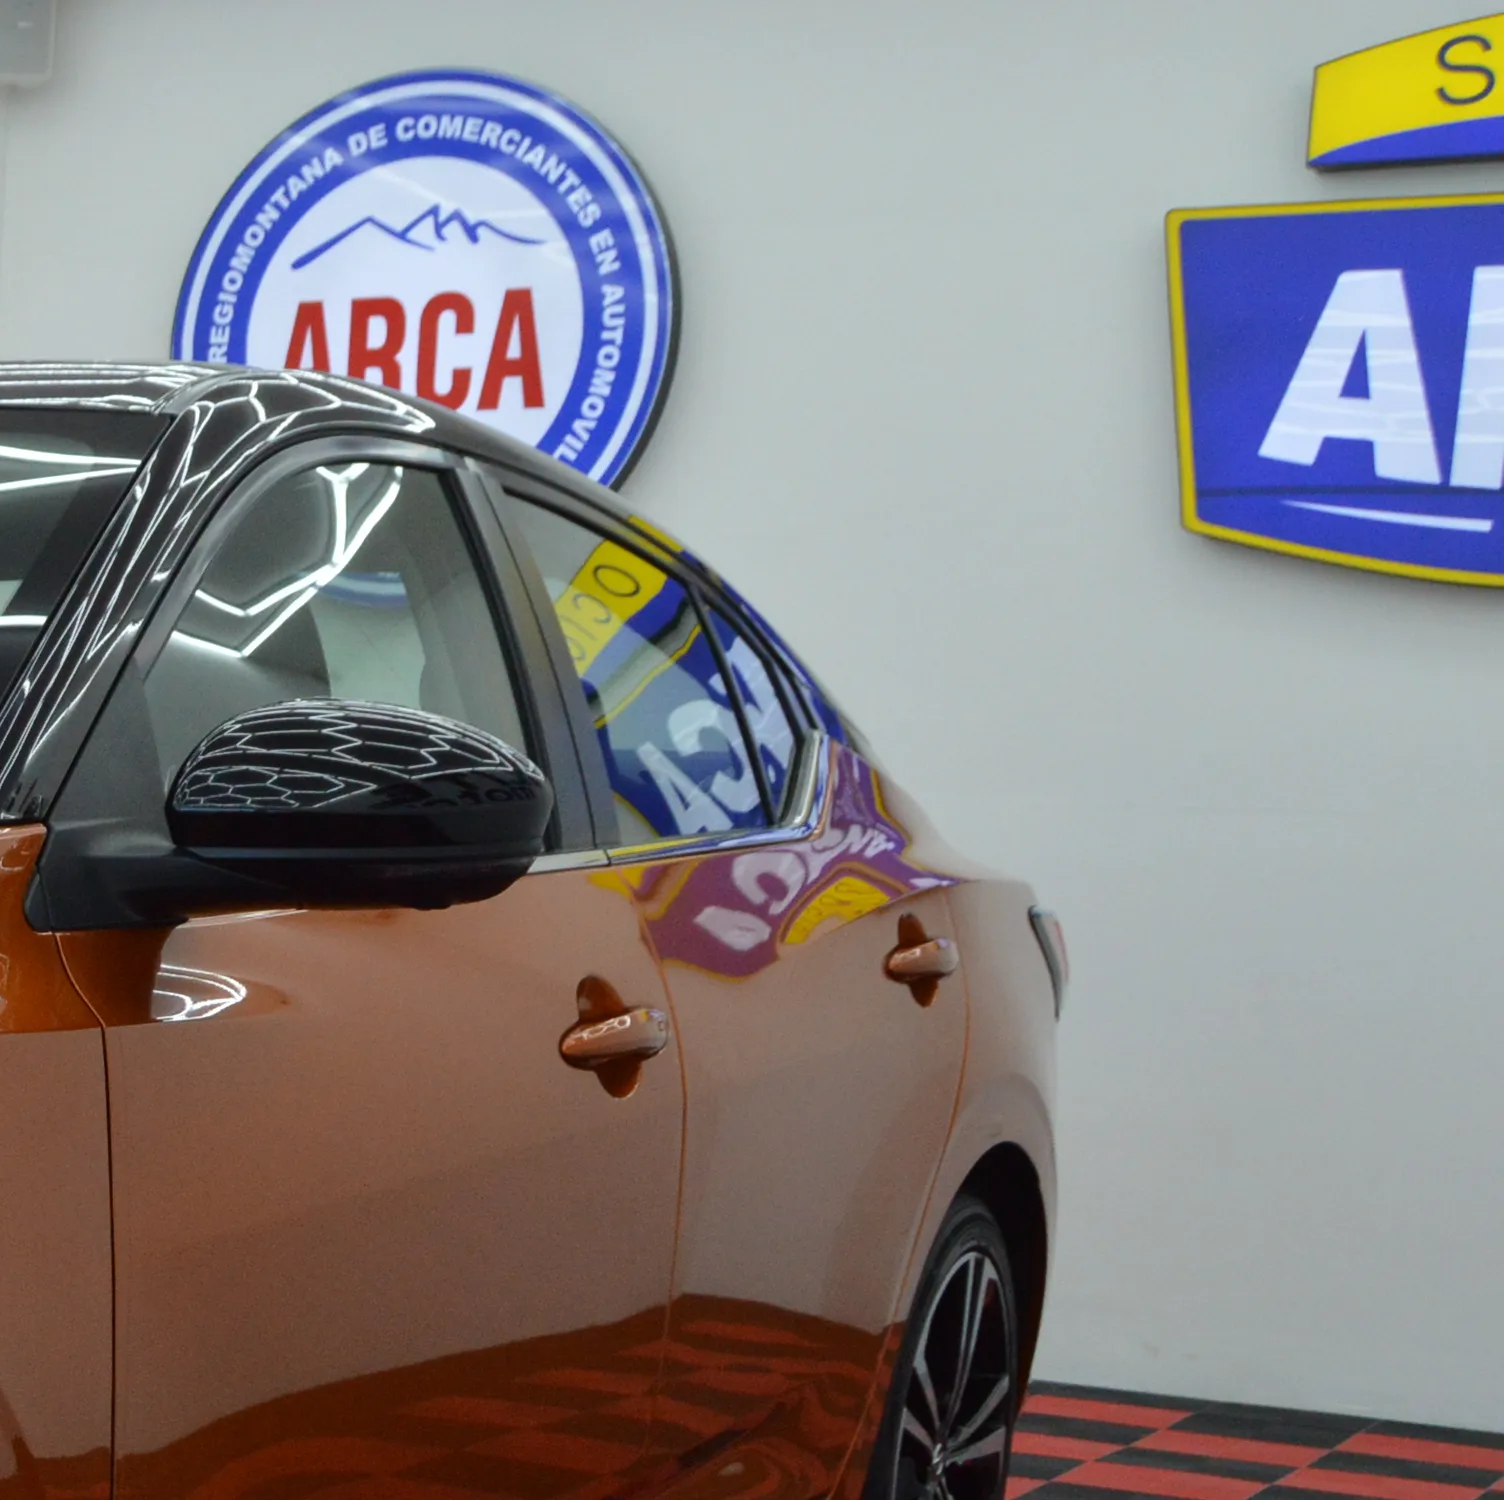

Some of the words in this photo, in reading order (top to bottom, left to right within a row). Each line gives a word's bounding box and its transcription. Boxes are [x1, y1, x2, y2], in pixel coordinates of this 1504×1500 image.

[207, 147, 344, 363] REGIOMONTANA
[346, 122, 389, 158] DE
[395, 114, 602, 229] COMERCIANTES
[588, 227, 622, 276] EN
[284, 286, 546, 412] ARCA
